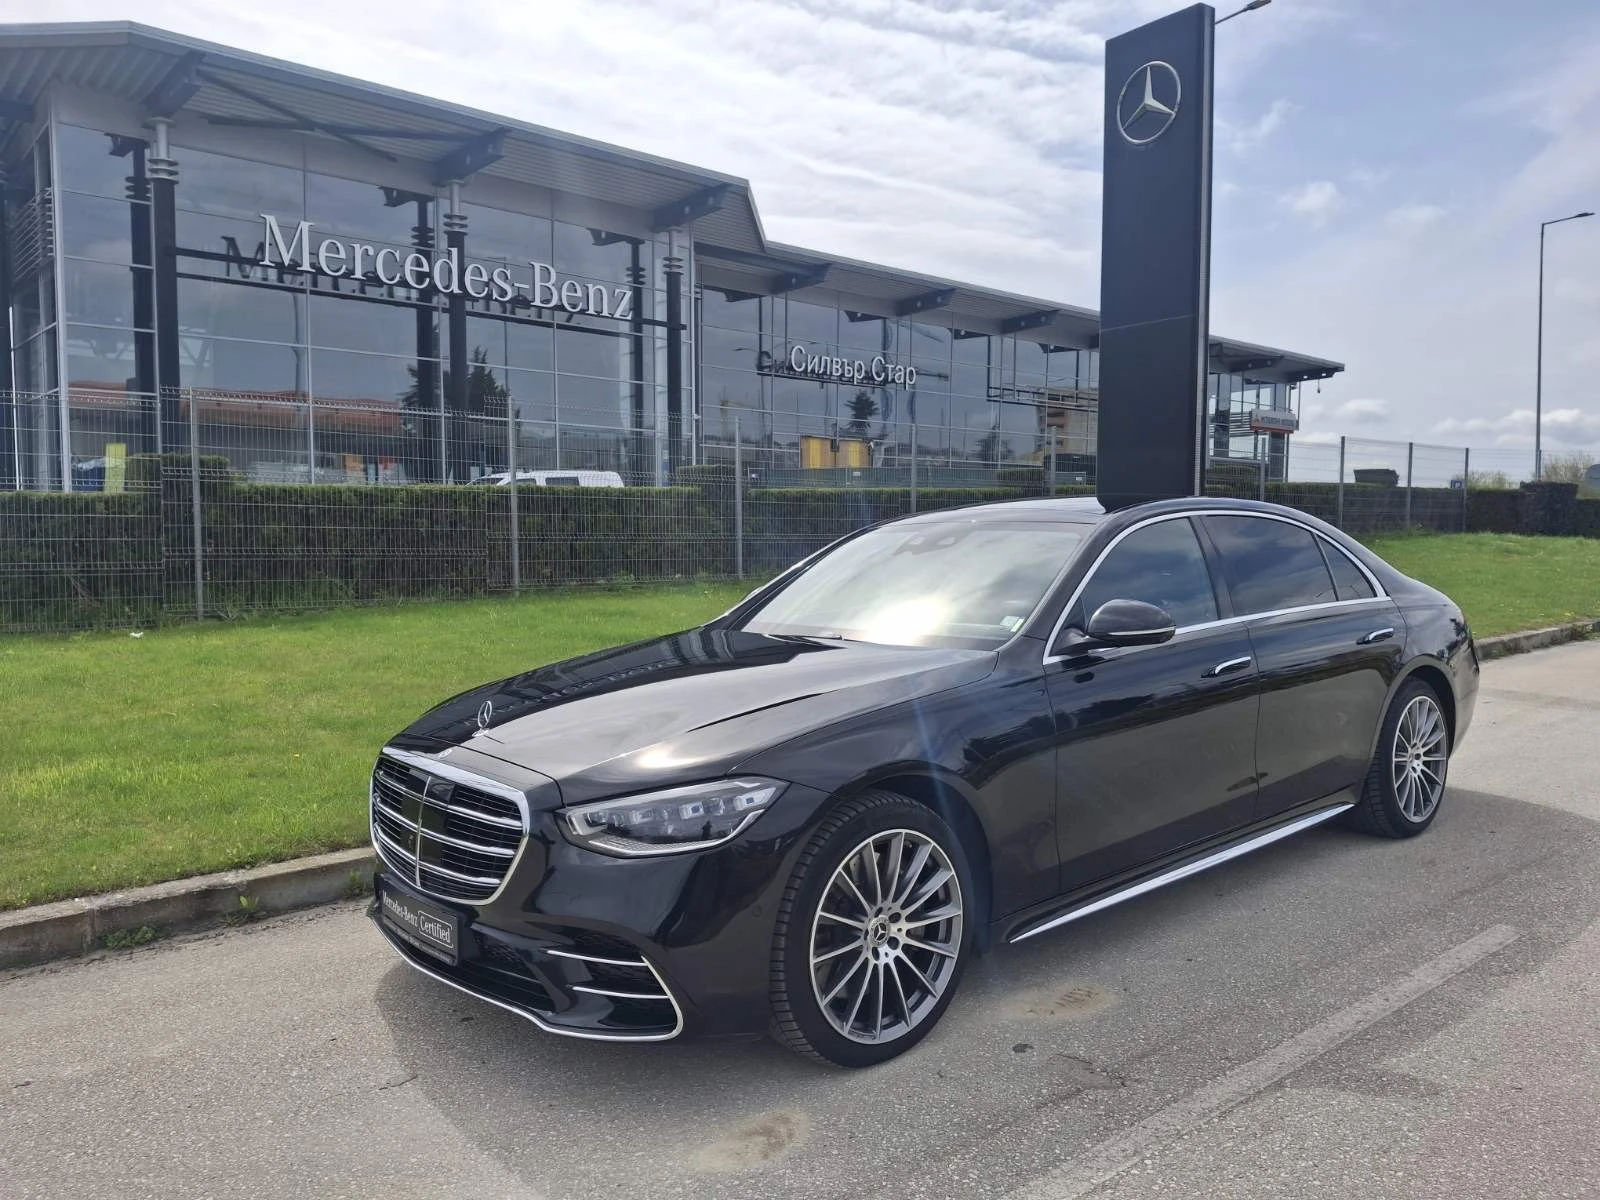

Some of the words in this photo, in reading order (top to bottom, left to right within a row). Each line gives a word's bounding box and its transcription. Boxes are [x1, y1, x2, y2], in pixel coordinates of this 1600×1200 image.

[260, 213, 633, 320] Mercedes-Benz
[791, 345, 865, 384] Силвър
[871, 356, 917, 390] Стар
[420, 915, 451, 943] Certified
